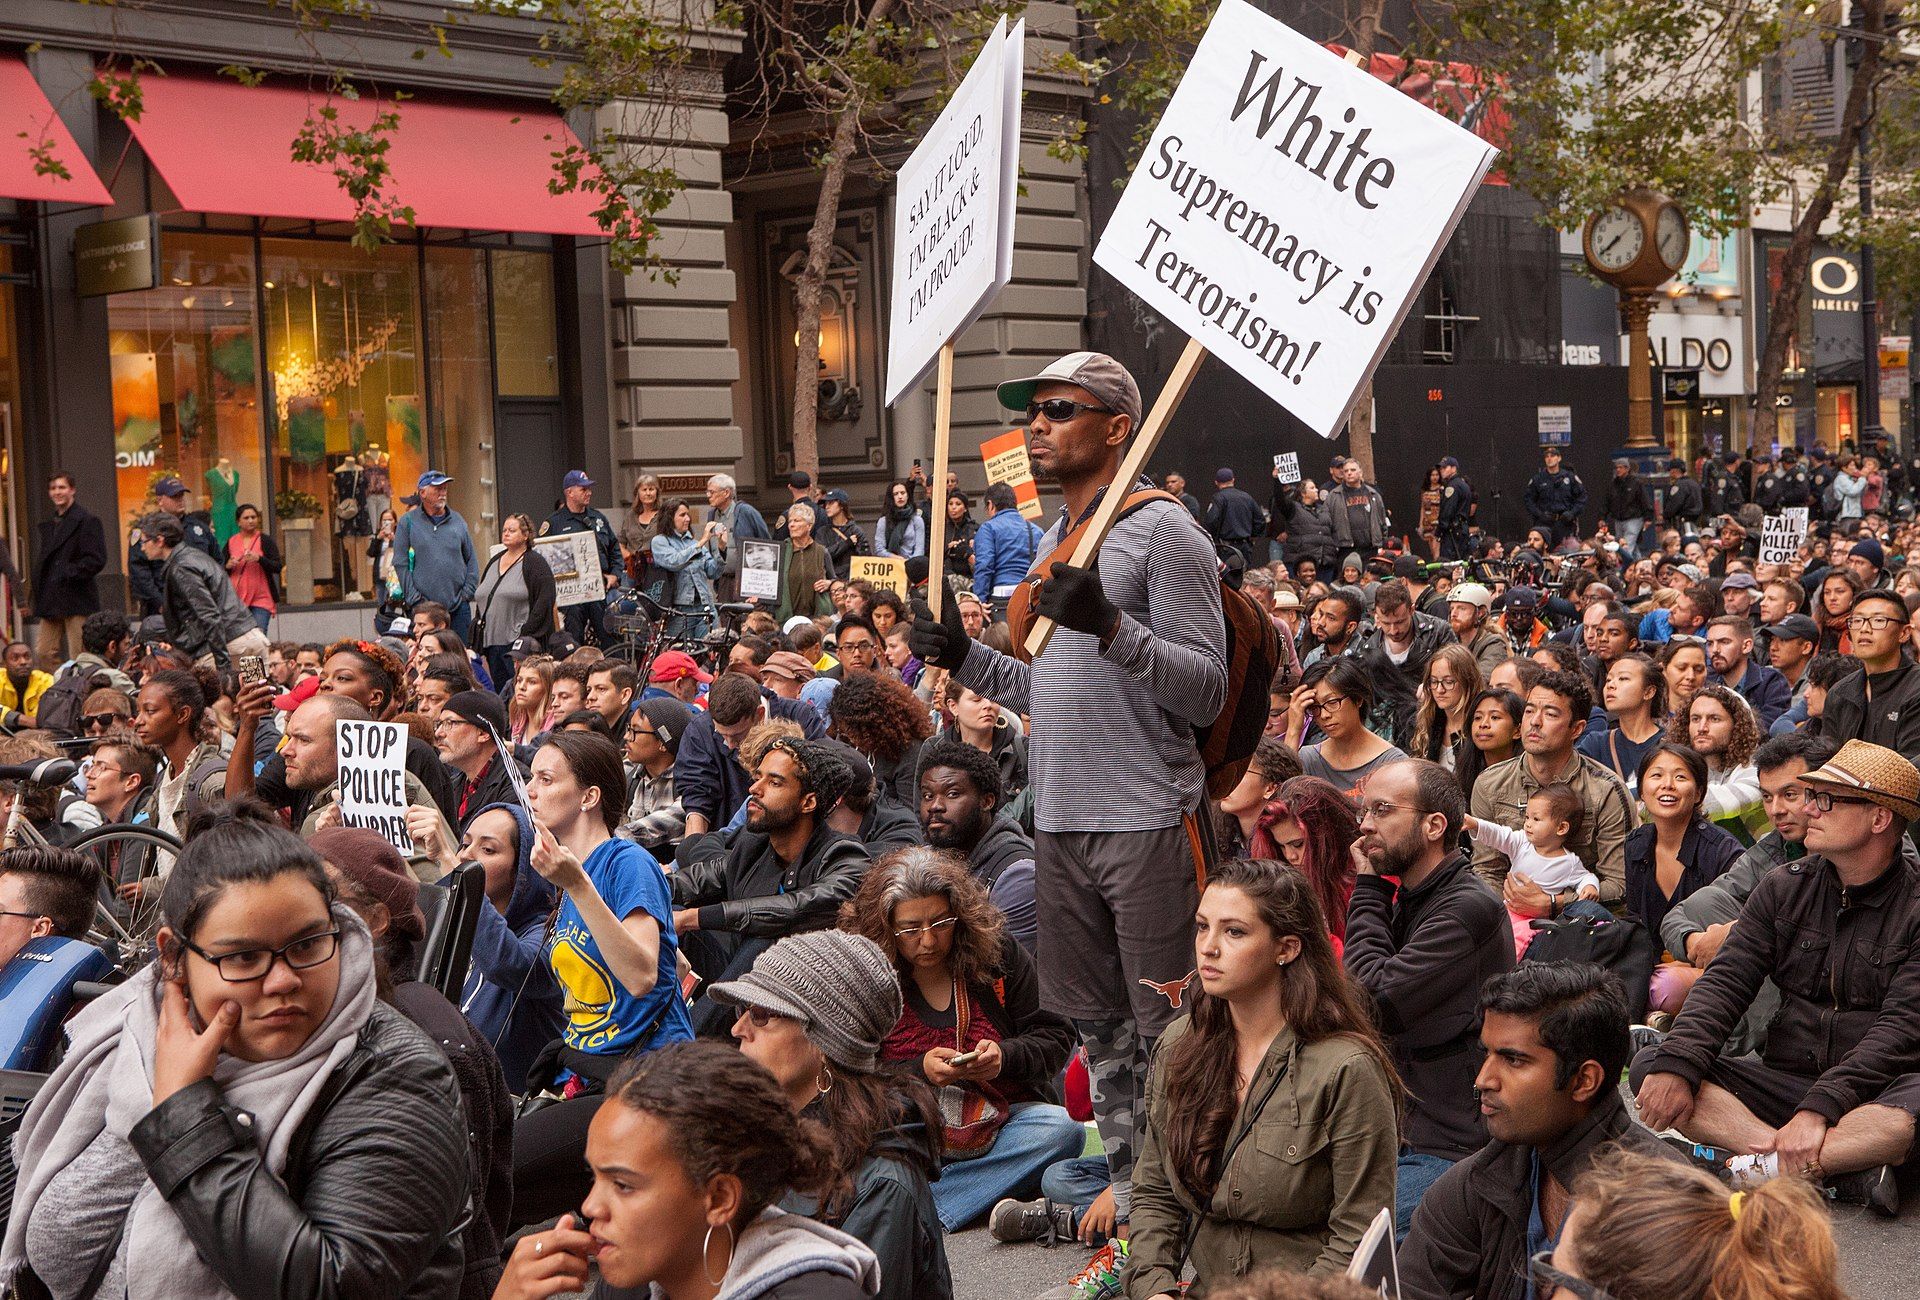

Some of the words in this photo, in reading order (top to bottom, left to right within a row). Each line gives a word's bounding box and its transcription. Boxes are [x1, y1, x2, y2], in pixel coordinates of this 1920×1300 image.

[1229, 49, 1396, 210] White
[909, 187, 933, 234] SAY
[933, 163, 947, 205] IT
[948, 113, 985, 184] LOUD,
[908, 233, 928, 281] I'M
[929, 177, 968, 254] BLACK
[970, 166, 981, 198] &
[1149, 135, 1343, 305] Supremacy
[1339, 265, 1384, 326] is
[907, 279, 927, 325] I'M
[928, 217, 975, 299] PROUD!
[1134, 218, 1322, 386] Terrorism!
[1813, 299, 1859, 312] AKLEY
[987, 459, 1001, 470] Black
[1276, 454, 1293, 465] JAIL
[991, 467, 1006, 477] Black
[1007, 471, 1027, 482] matter
[1281, 472, 1299, 482] COPS
[1764, 518, 1795, 533] JAIL
[1762, 534, 1800, 549] KILLER
[1763, 550, 1798, 563] COPS
[863, 562, 894, 577] STOP
[341, 722, 398, 759] STOP
[340, 765, 403, 807] POLICE
[564, 1023, 621, 1050] OLICE
